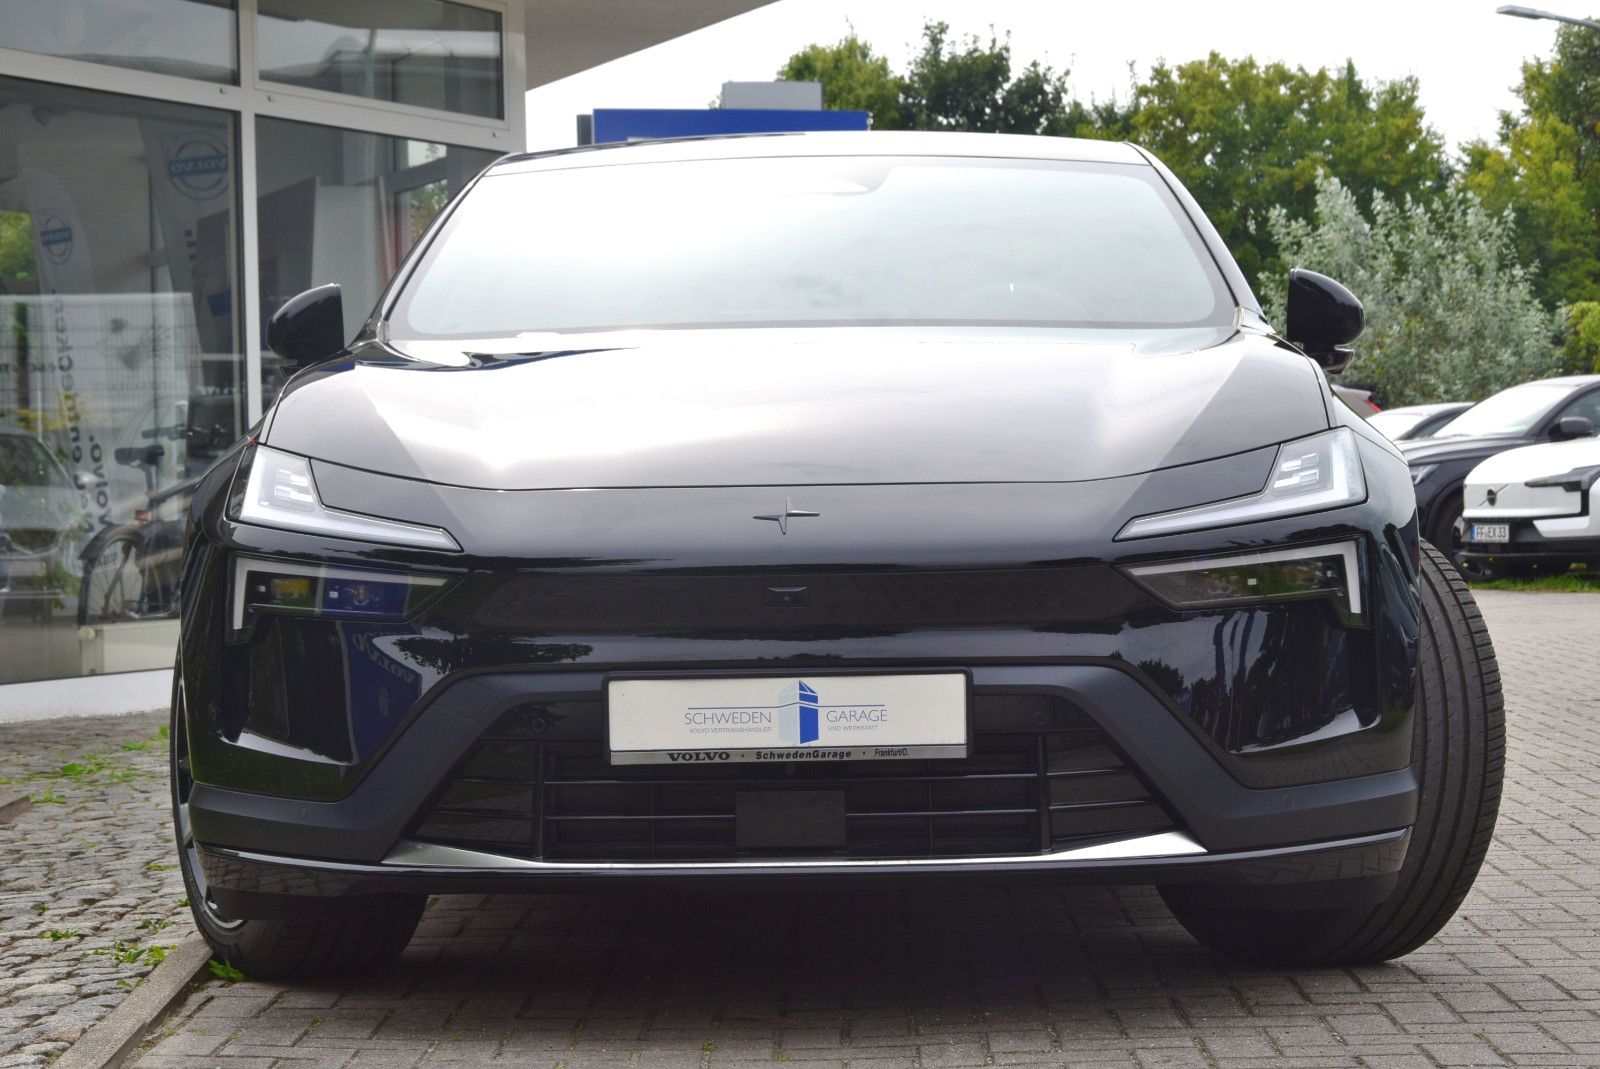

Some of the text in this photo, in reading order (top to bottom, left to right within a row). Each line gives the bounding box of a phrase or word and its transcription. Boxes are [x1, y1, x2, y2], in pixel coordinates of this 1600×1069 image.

[1476, 526, 1507, 538] FF EX 33
[684, 709, 888, 725] SCHWEDEN GARAGE
[667, 751, 730, 761] VOLVO
[755, 749, 852, 760] SchwedenGarage
